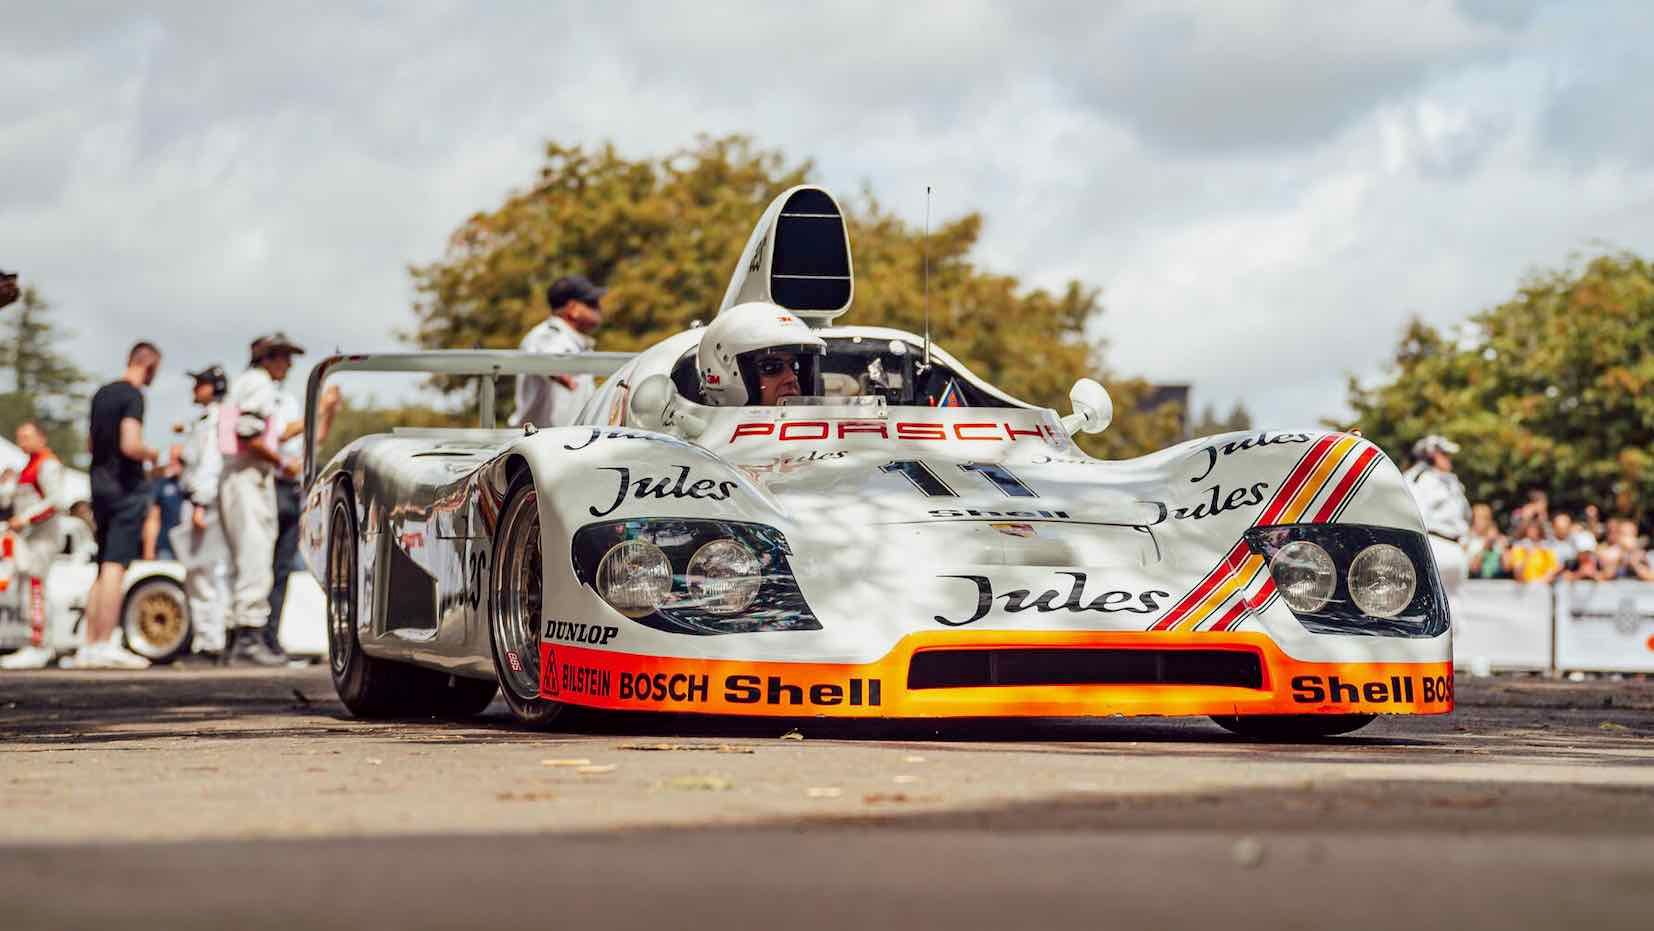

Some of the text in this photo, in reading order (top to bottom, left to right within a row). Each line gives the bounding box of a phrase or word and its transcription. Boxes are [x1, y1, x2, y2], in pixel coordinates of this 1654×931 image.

[878, 458, 1040, 498] 11
[1190, 432, 1310, 482] Jules
[588, 465, 738, 517] Jules
[1134, 482, 1269, 530] Jules
[928, 509, 1070, 520] Shell
[934, 571, 1169, 627] Jules
[544, 620, 619, 645] DUNLOP
[562, 663, 881, 707] BILSTEIN BOSCH Shell
[1291, 675, 1414, 704] Shell
